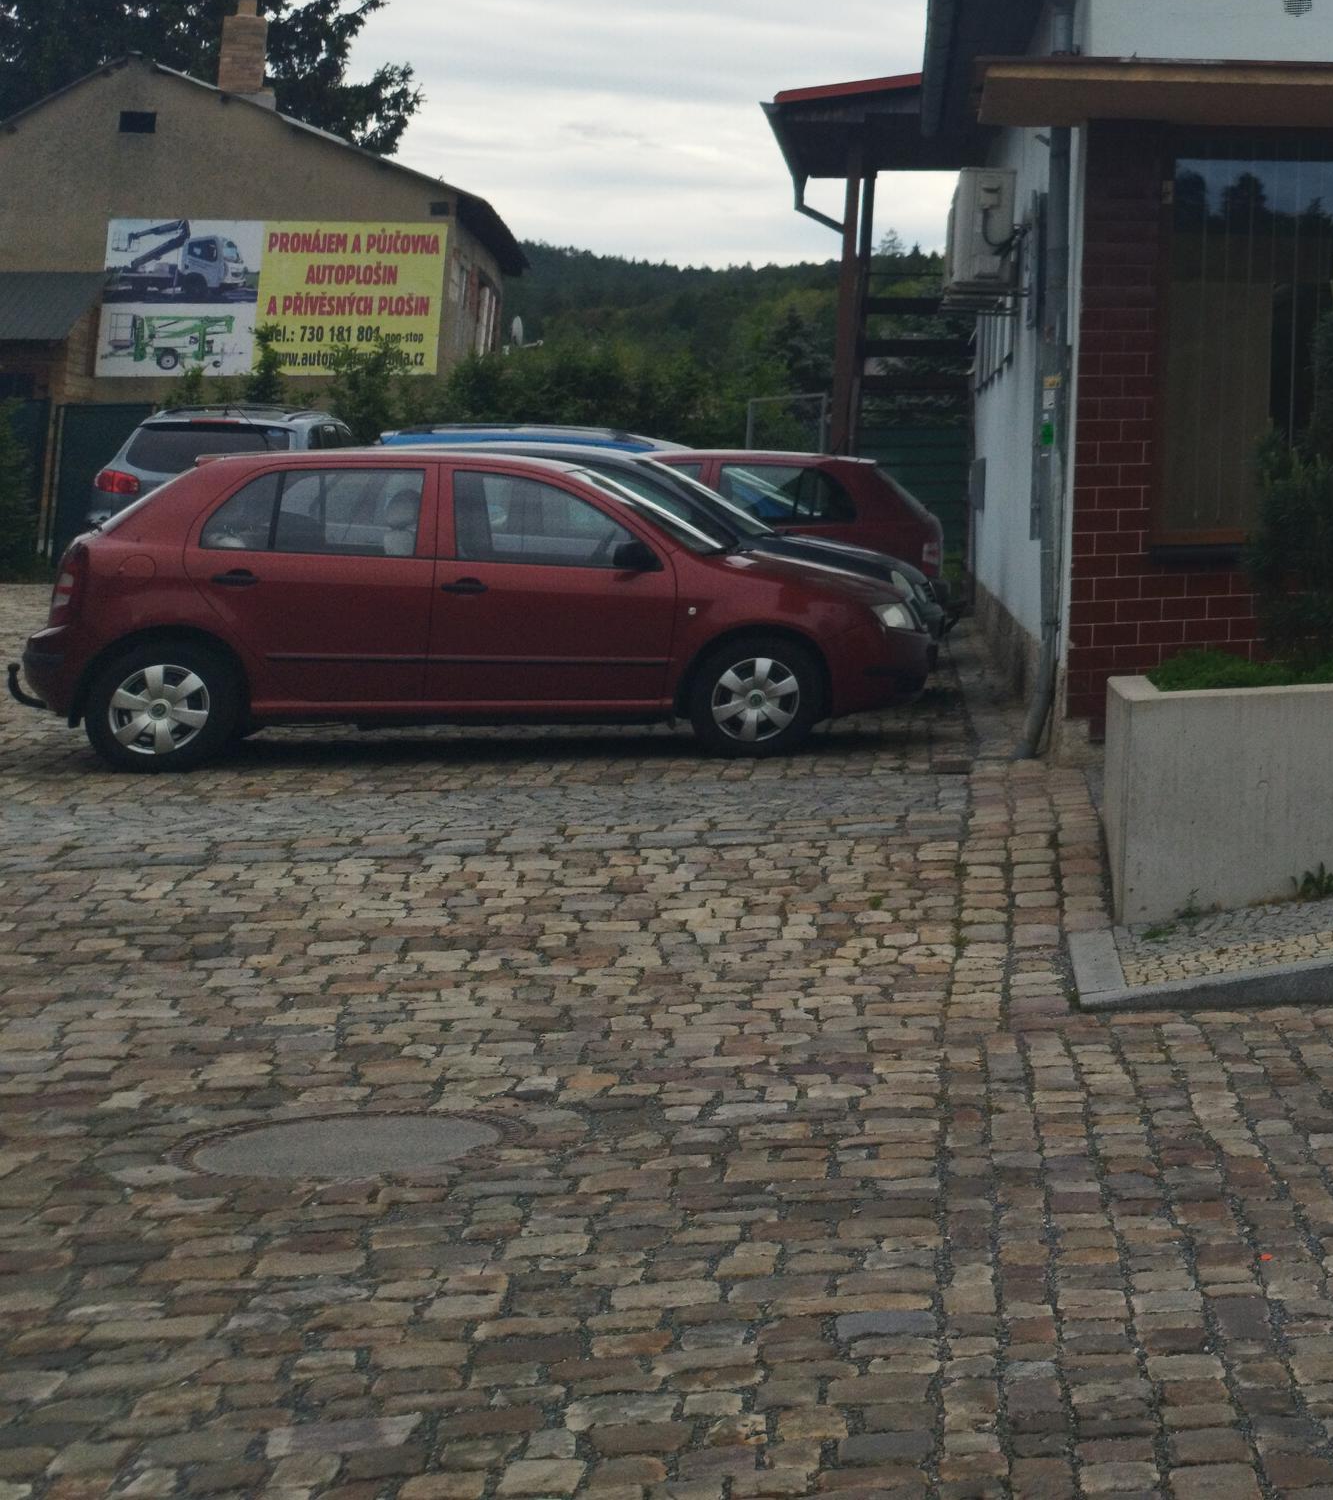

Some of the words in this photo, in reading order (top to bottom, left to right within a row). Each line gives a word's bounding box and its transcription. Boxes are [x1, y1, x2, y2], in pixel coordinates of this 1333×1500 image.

[268, 229, 348, 253] PRONÁJEM
[351, 234, 361, 253] A
[366, 228, 440, 254] PŮJČOVNA
[305, 261, 398, 285] AUTOPLOŠIN
[266, 296, 277, 316] A
[282, 291, 373, 316] PŘÍVĚSNÝCH
[378, 293, 430, 316] PLOŠIN
[300, 325, 324, 342] 730
[329, 325, 352, 342] 181
[385, 331, 424, 344] non-stop
